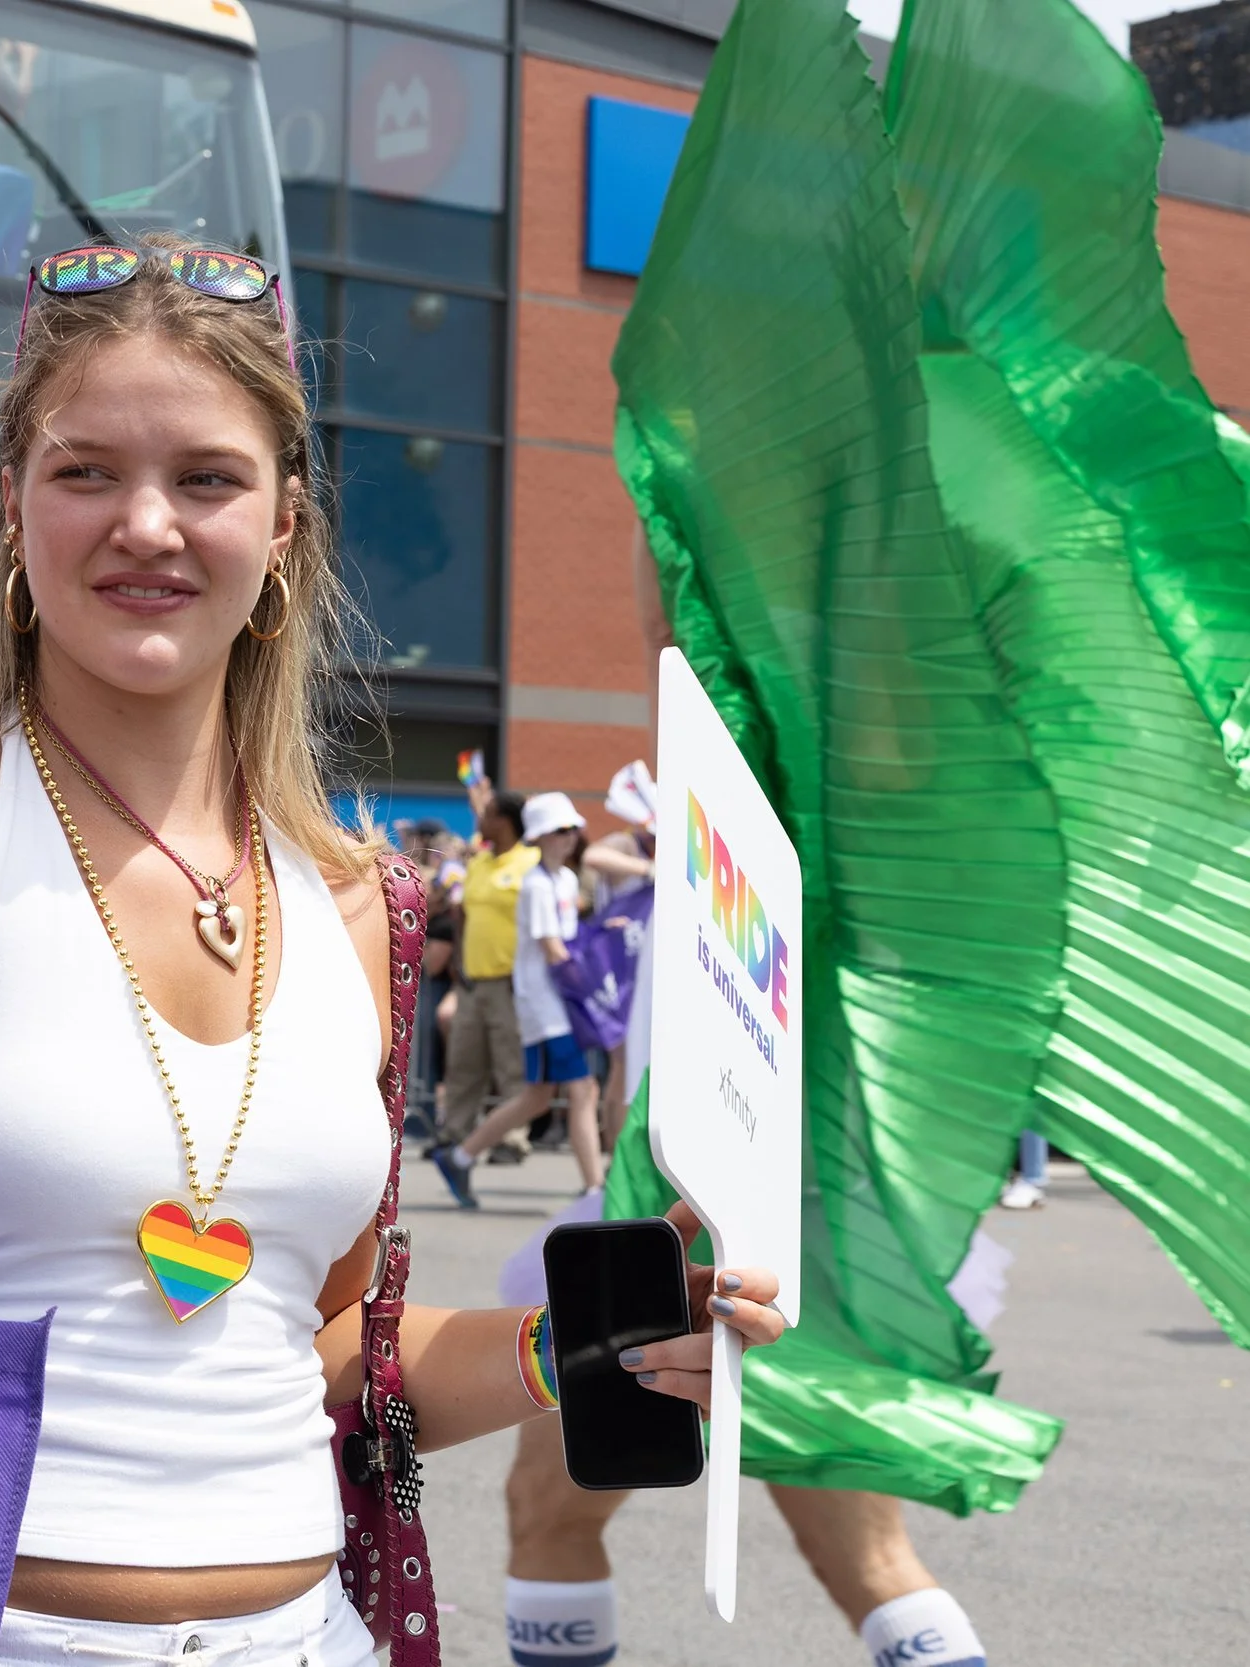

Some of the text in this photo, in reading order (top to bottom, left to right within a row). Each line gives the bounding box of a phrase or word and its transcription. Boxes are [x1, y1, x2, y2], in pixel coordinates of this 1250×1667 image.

[686, 785, 788, 1034] PRIDE
[697, 923, 778, 1076] is universal.
[718, 1066, 757, 1143] xfinity
